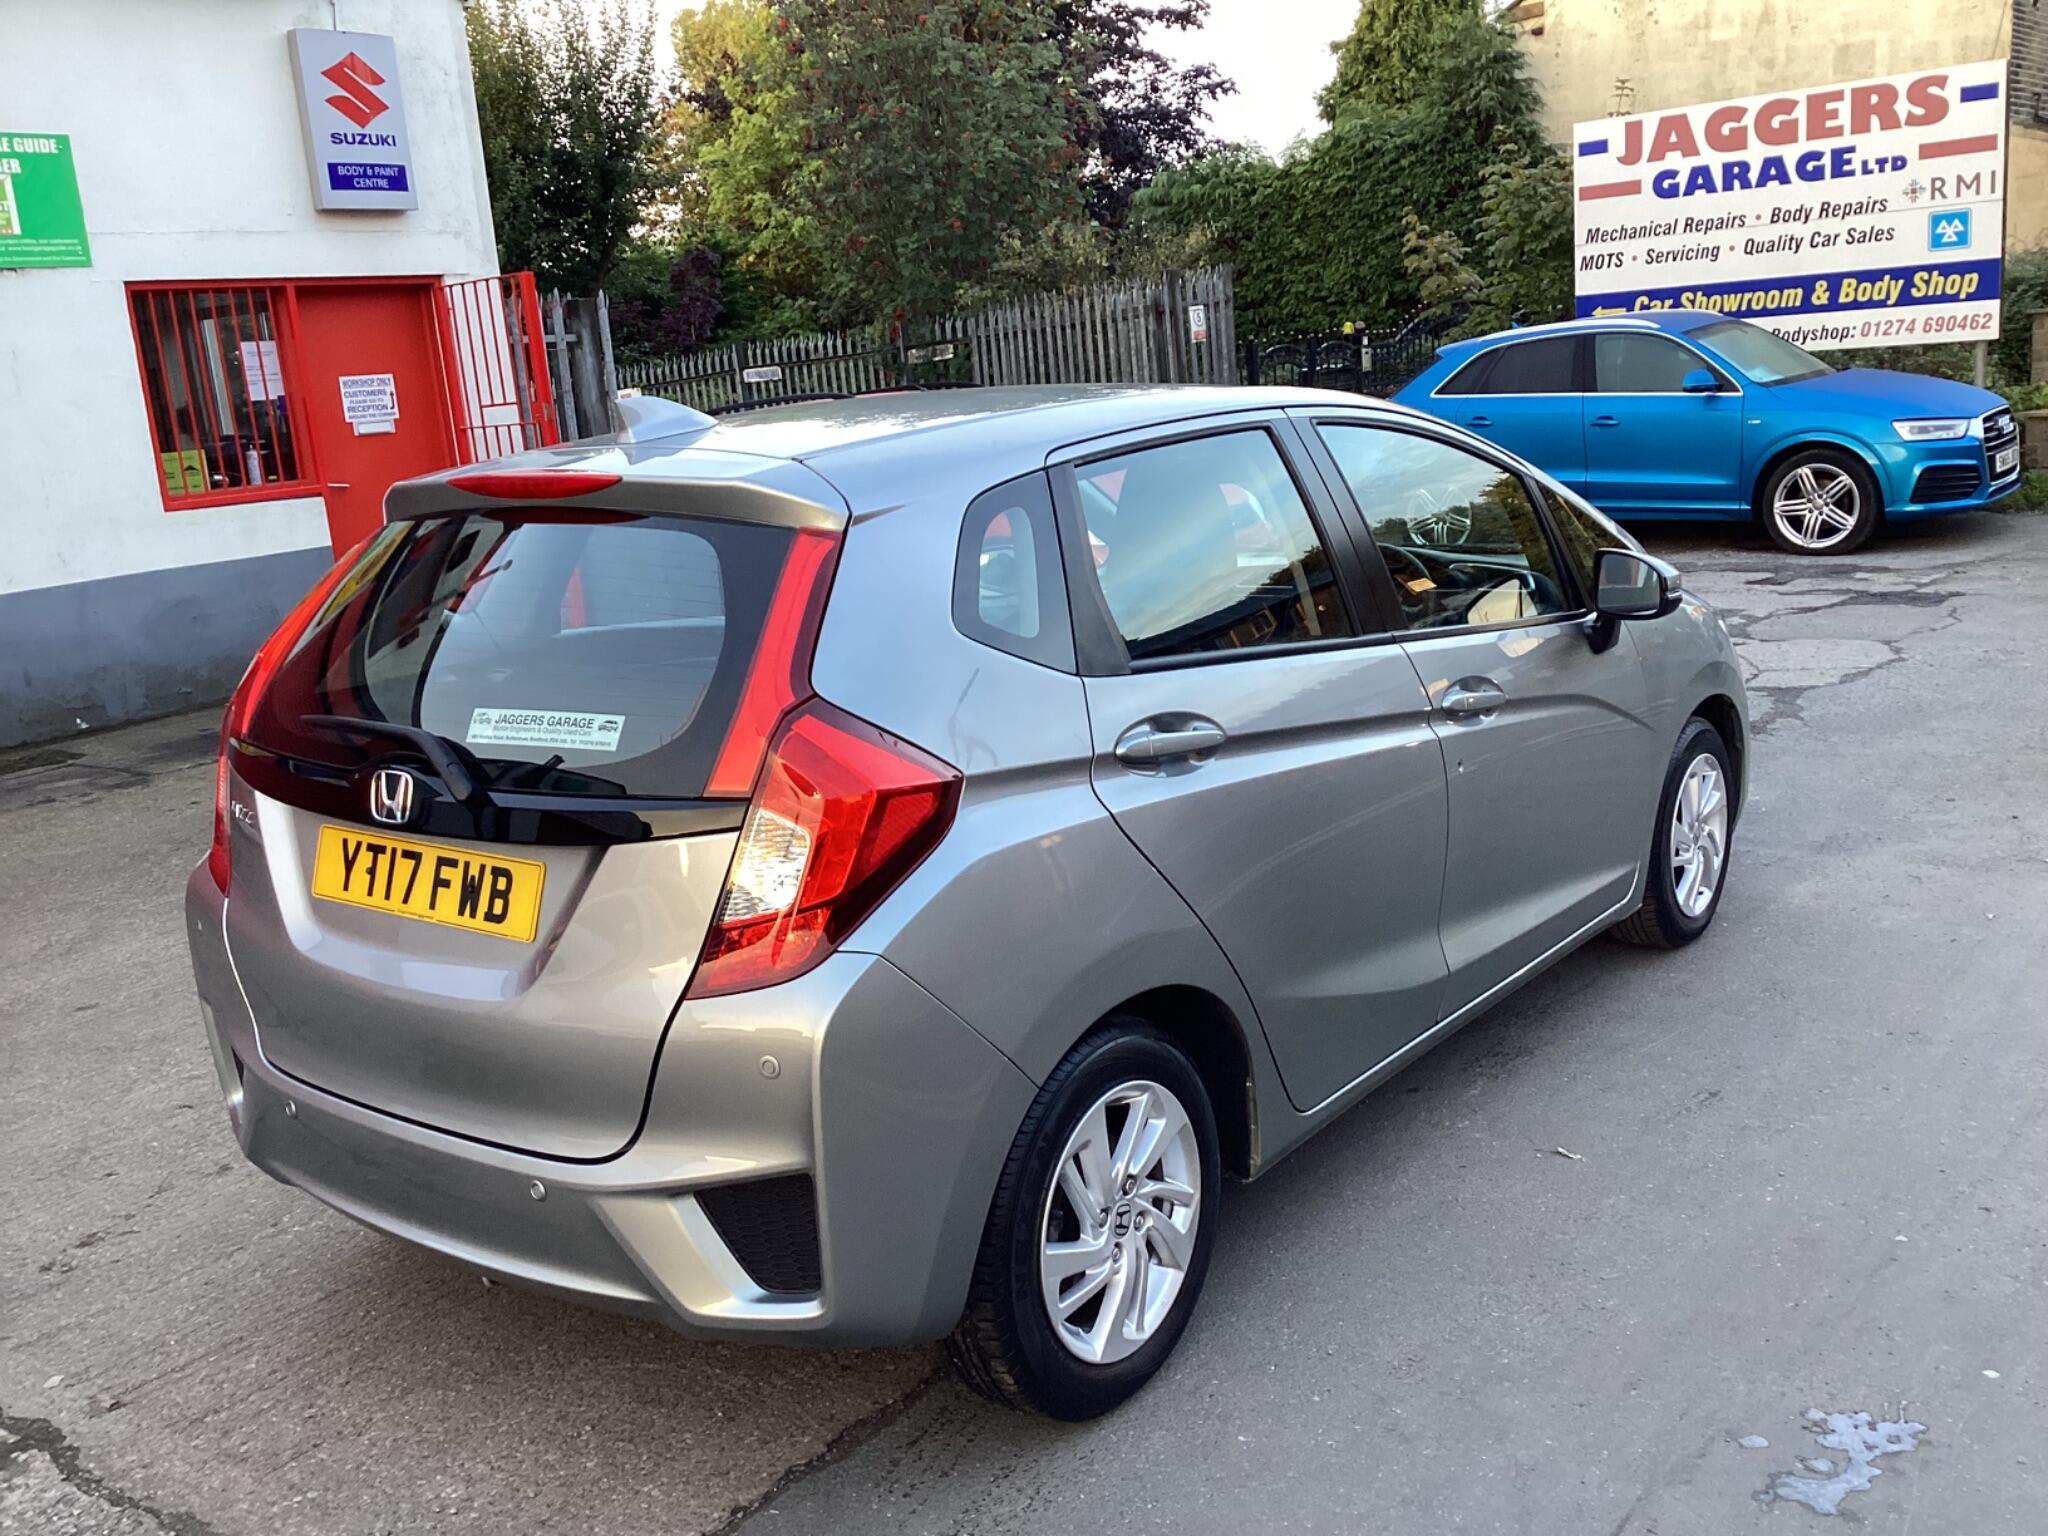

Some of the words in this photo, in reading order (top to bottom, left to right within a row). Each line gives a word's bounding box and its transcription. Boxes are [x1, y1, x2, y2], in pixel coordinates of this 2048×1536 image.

[1616, 74, 1950, 166] JAGGERS
[12, 137, 59, 154] GUIDE
[330, 132, 396, 147] SUZUKI
[337, 165, 364, 176] BODY
[366, 166, 373, 176] &
[374, 166, 399, 177] PAINT
[353, 177, 390, 189] CENTRE
[1652, 145, 1856, 199] GARAGE
[1861, 155, 1908, 176] LTD
[1930, 170, 1997, 201] RMI
[1585, 218, 1679, 245] Mechanical
[1683, 211, 1746, 235] Repairs
[1770, 204, 1813, 225] Body
[1818, 196, 1888, 220] Repairs
[1580, 251, 1625, 272] MOTS
[1645, 243, 1720, 263] Servicing
[1744, 234, 1804, 257] Quality
[1809, 231, 1840, 249] Car
[1845, 225, 1895, 245] Sales
[1681, 286, 1804, 313] Showroom
[1811, 279, 1831, 306] &
[1838, 274, 1905, 306] Body
[1911, 270, 1979, 300] Shop
[1860, 317, 1917, 338] 01274
[1922, 312, 1993, 334] 690462
[344, 389, 387, 398] CUSTOMERS
[347, 404, 388, 413] RECEPTION
[495, 713, 545, 727] JAGGERS
[546, 715, 596, 730] GARAGE
[341, 837, 423, 905] YT17
[429, 855, 513, 925] FWB
